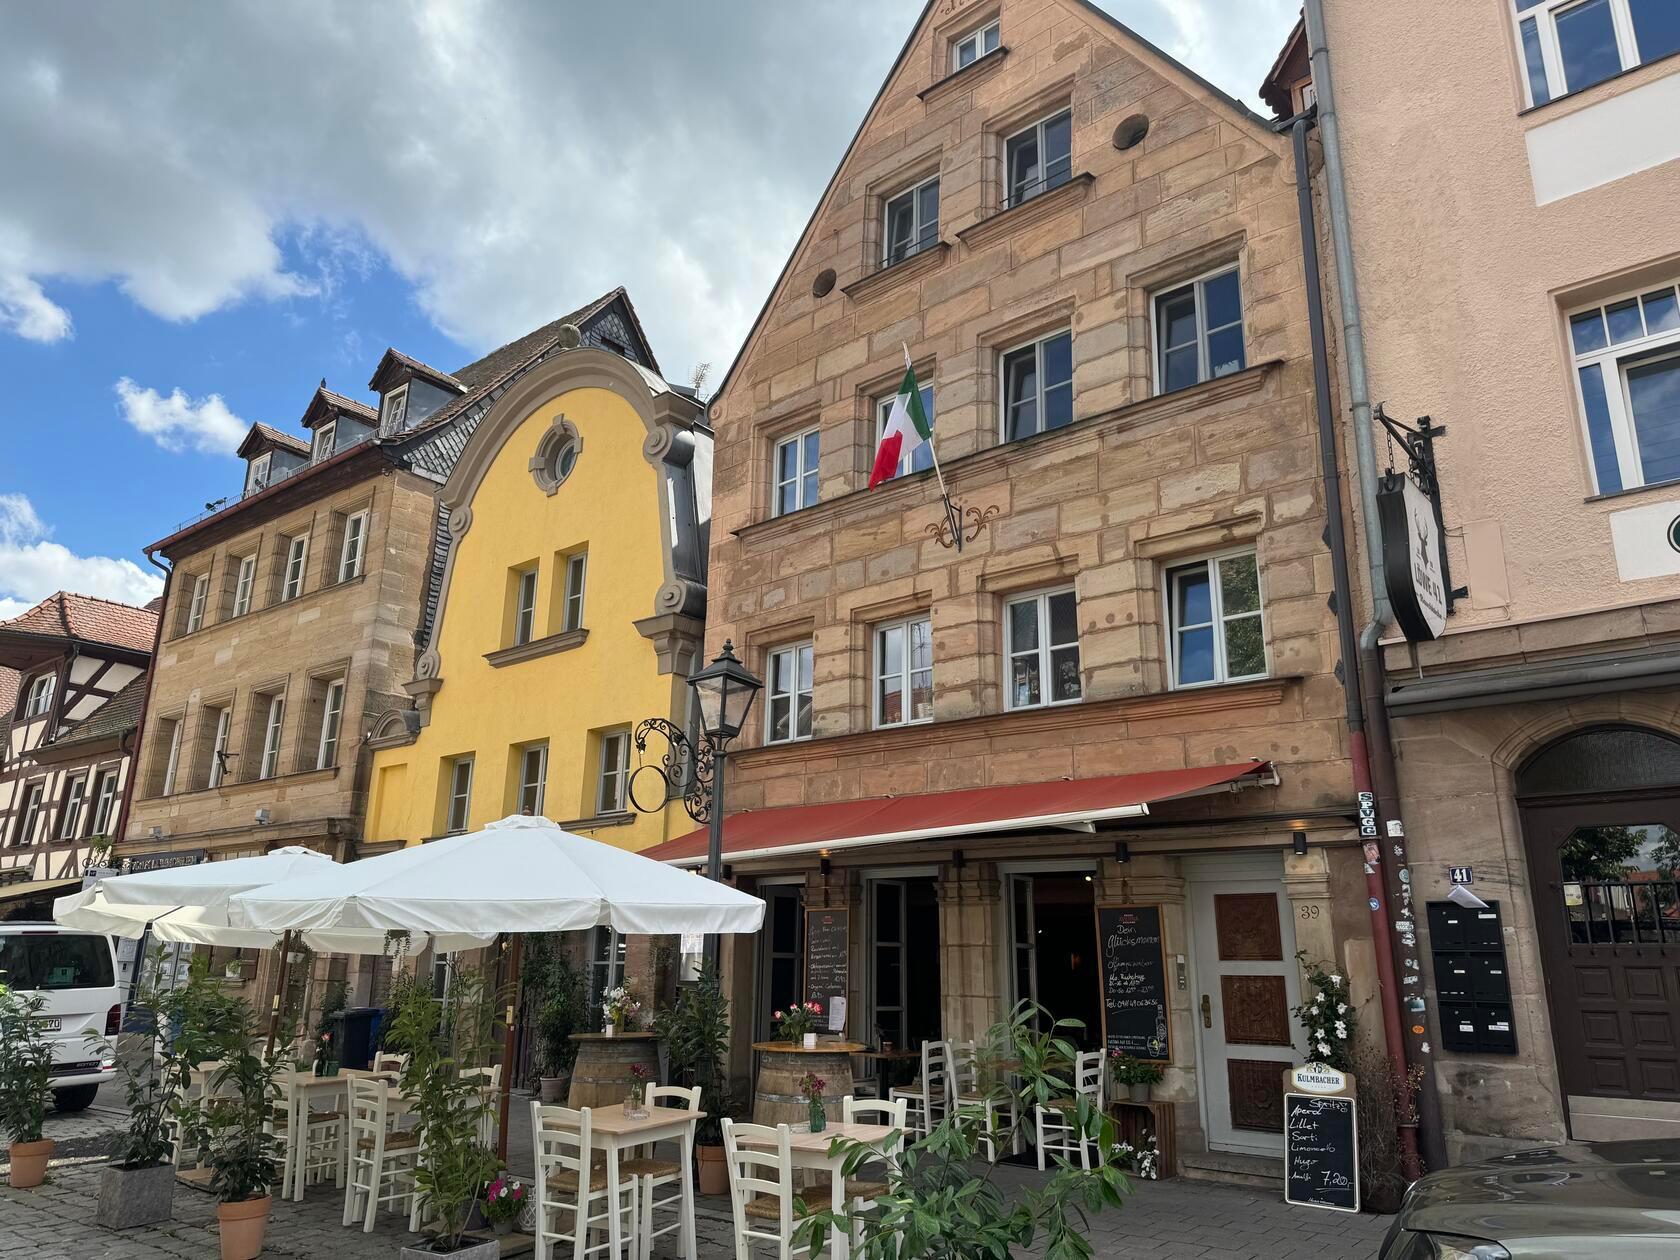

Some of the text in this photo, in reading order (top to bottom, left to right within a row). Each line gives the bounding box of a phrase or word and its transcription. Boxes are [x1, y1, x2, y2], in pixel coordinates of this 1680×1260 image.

[1414, 562, 1432, 596] LÖWE
[1359, 792, 1376, 835] SPVGG
[1453, 868, 1469, 882] 41
[1301, 905, 1320, 920] 39
[1297, 1073, 1340, 1085] KULMBACHER
[1289, 1117, 1319, 1130] Lillet
[1292, 1130, 1318, 1142] Sarti
[1293, 1156, 1319, 1171] Hugo
